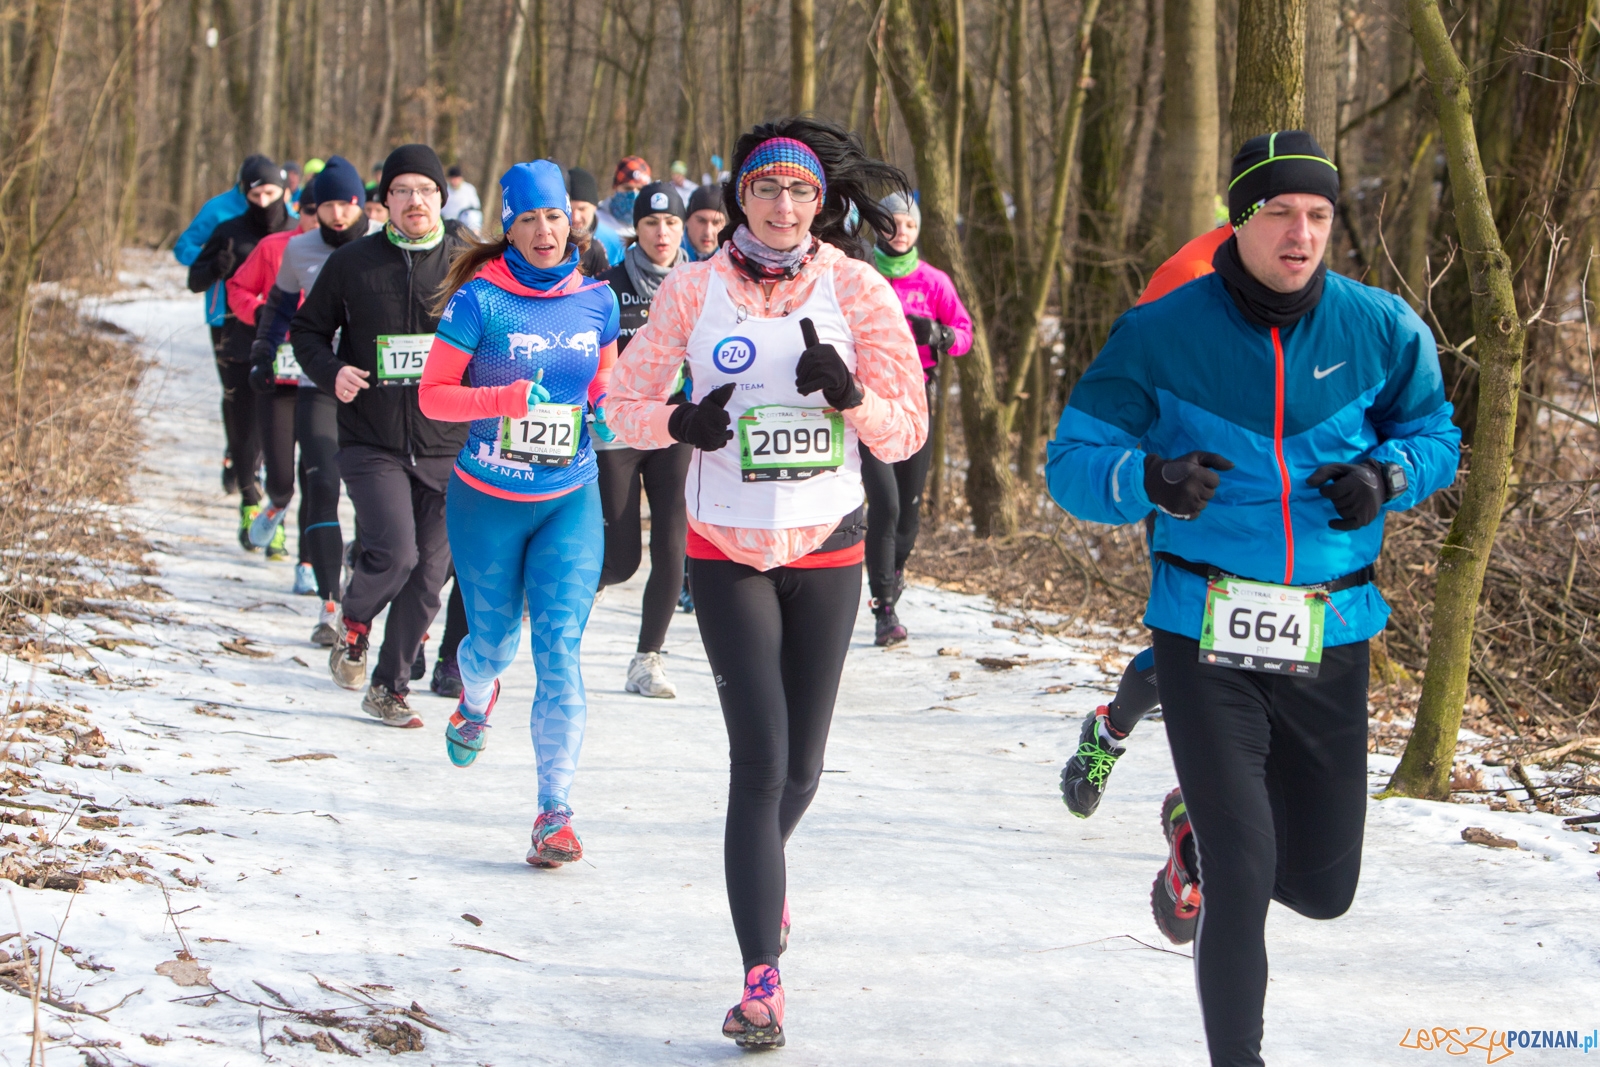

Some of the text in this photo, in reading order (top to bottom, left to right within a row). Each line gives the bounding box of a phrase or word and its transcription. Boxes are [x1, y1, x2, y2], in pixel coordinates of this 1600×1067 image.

[722, 346, 746, 363] PZU
[740, 383, 765, 391] TEAM
[519, 420, 571, 447] 1212
[751, 428, 830, 456] 2090
[1229, 607, 1301, 646] 664
[1256, 645, 1270, 654] PIT
